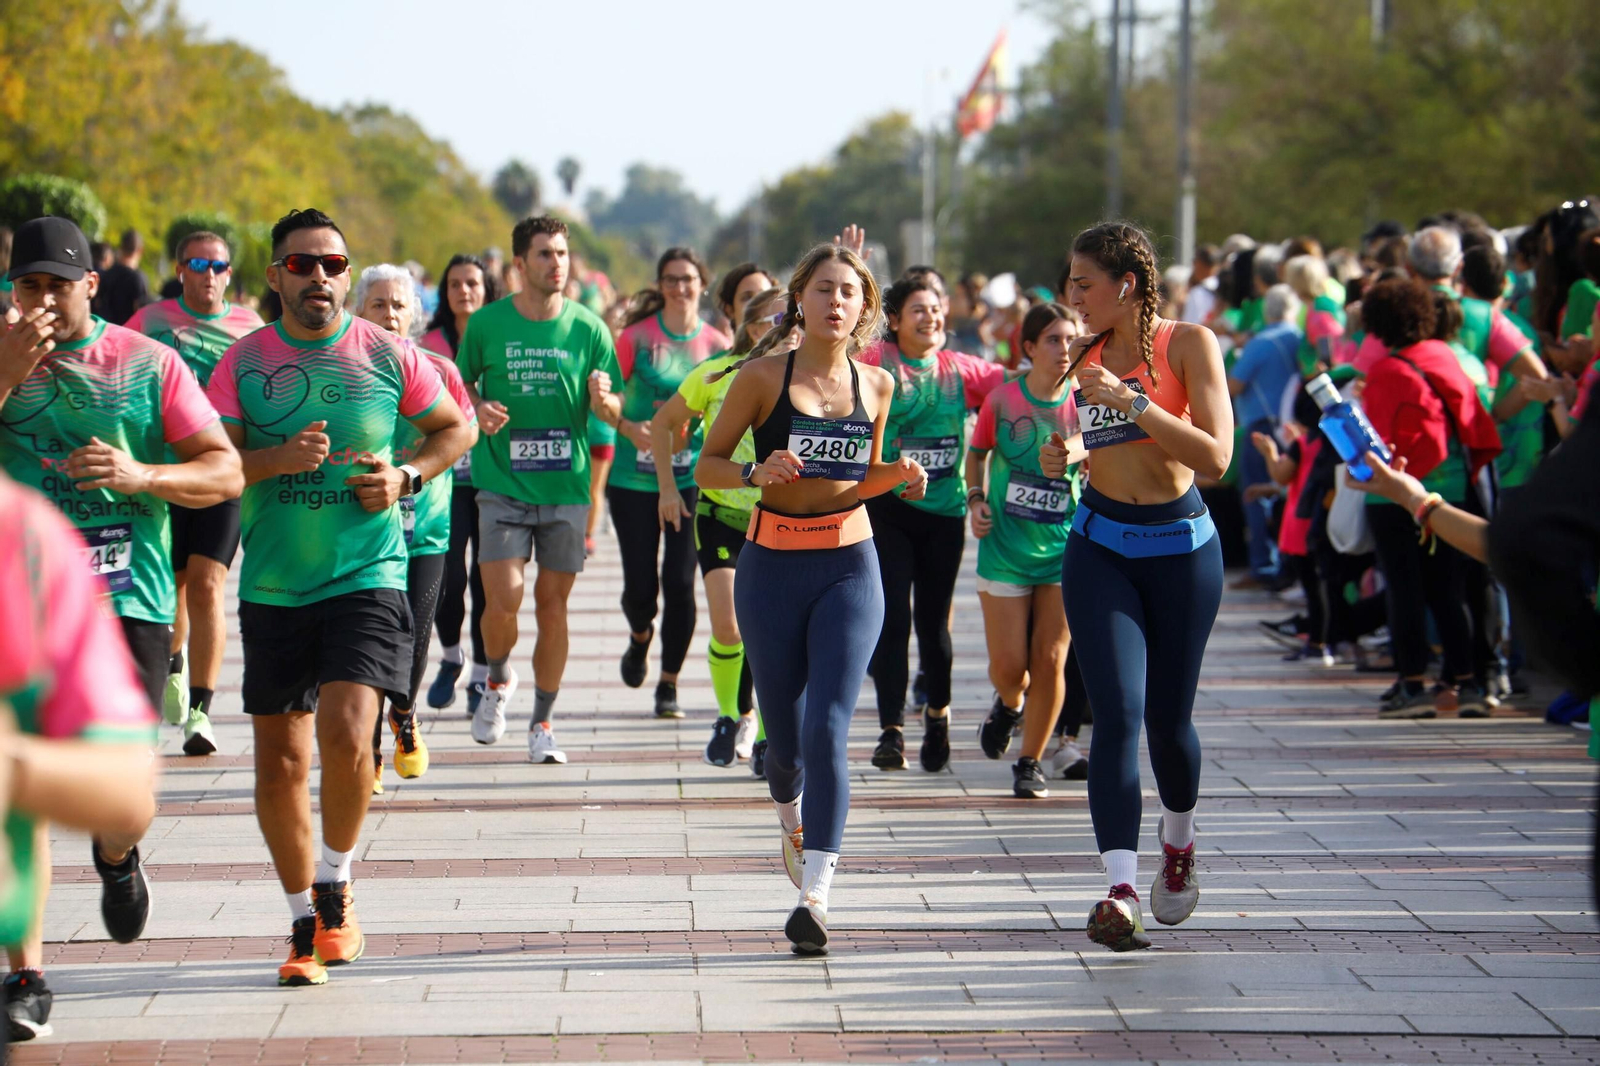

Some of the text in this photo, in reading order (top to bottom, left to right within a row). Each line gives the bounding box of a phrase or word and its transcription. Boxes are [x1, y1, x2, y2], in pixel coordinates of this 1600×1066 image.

[506, 347, 568, 359] En marcha
[507, 358, 543, 369] contra
[508, 369, 559, 380] el cáncer
[1096, 429, 1116, 437] marcha
[1098, 432, 1124, 442] engancha
[798, 438, 858, 459] 2480
[279, 470, 325, 489] que
[1015, 487, 1059, 509] 2449
[793, 523, 841, 533] LURBEL
